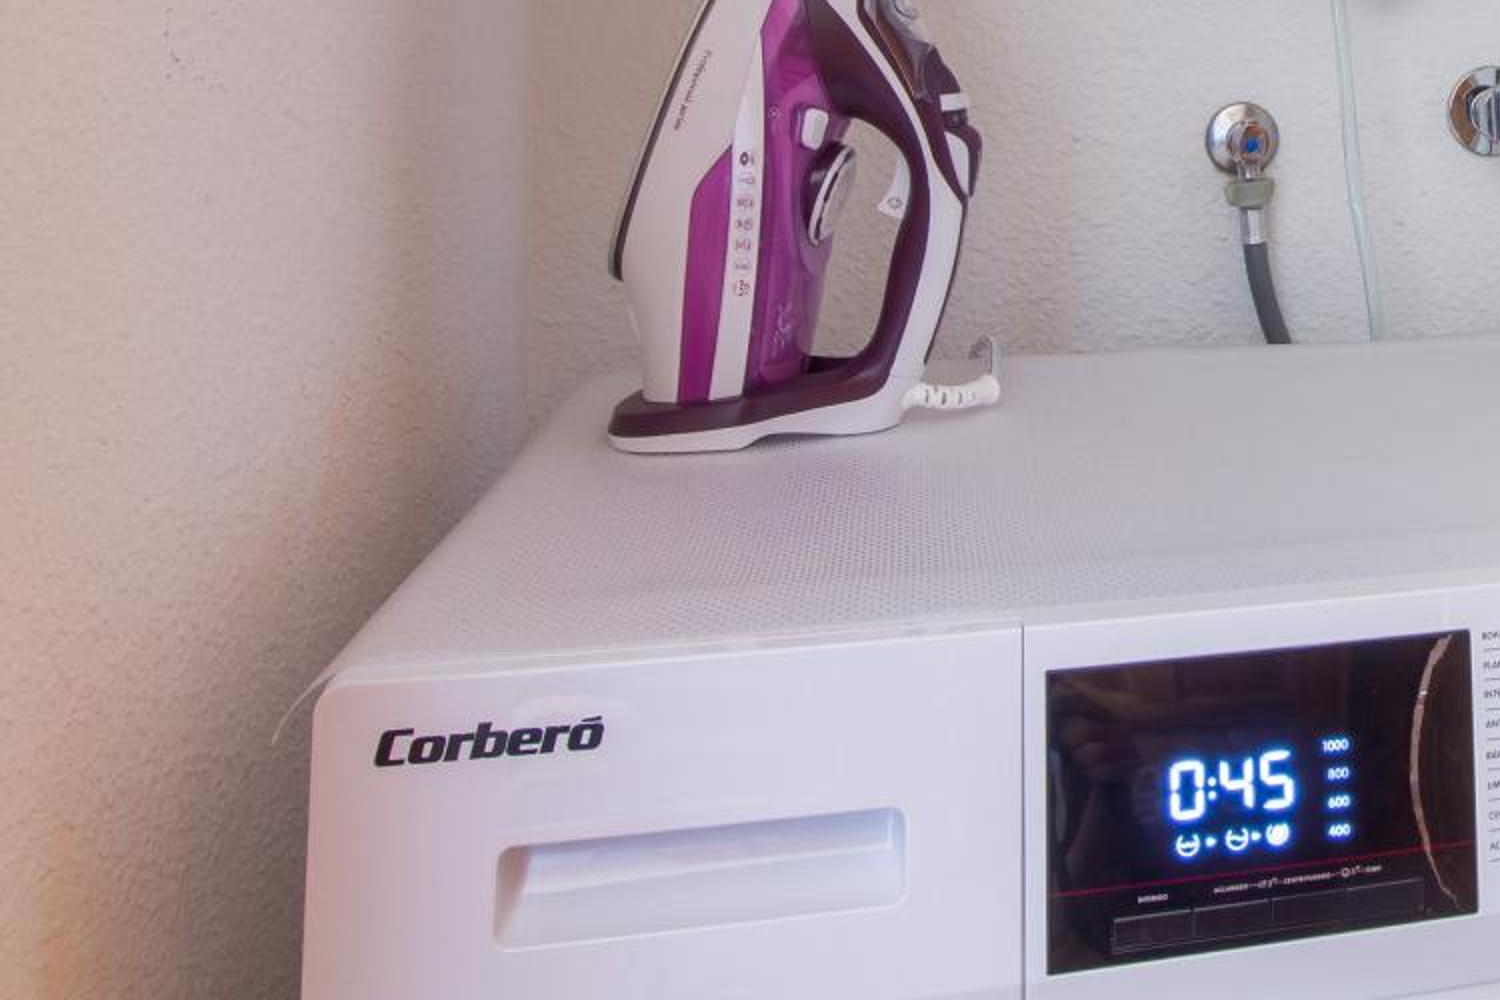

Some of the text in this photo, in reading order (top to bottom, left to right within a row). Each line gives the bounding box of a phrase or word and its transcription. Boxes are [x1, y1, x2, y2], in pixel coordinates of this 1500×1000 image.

[374, 715, 604, 767] Corberó
[1321, 737, 1350, 752] 1000
[1327, 766, 1350, 781] 800
[1169, 750, 1295, 821] 0:45
[1327, 794, 1351, 809] 600
[1327, 823, 1351, 838] 400
